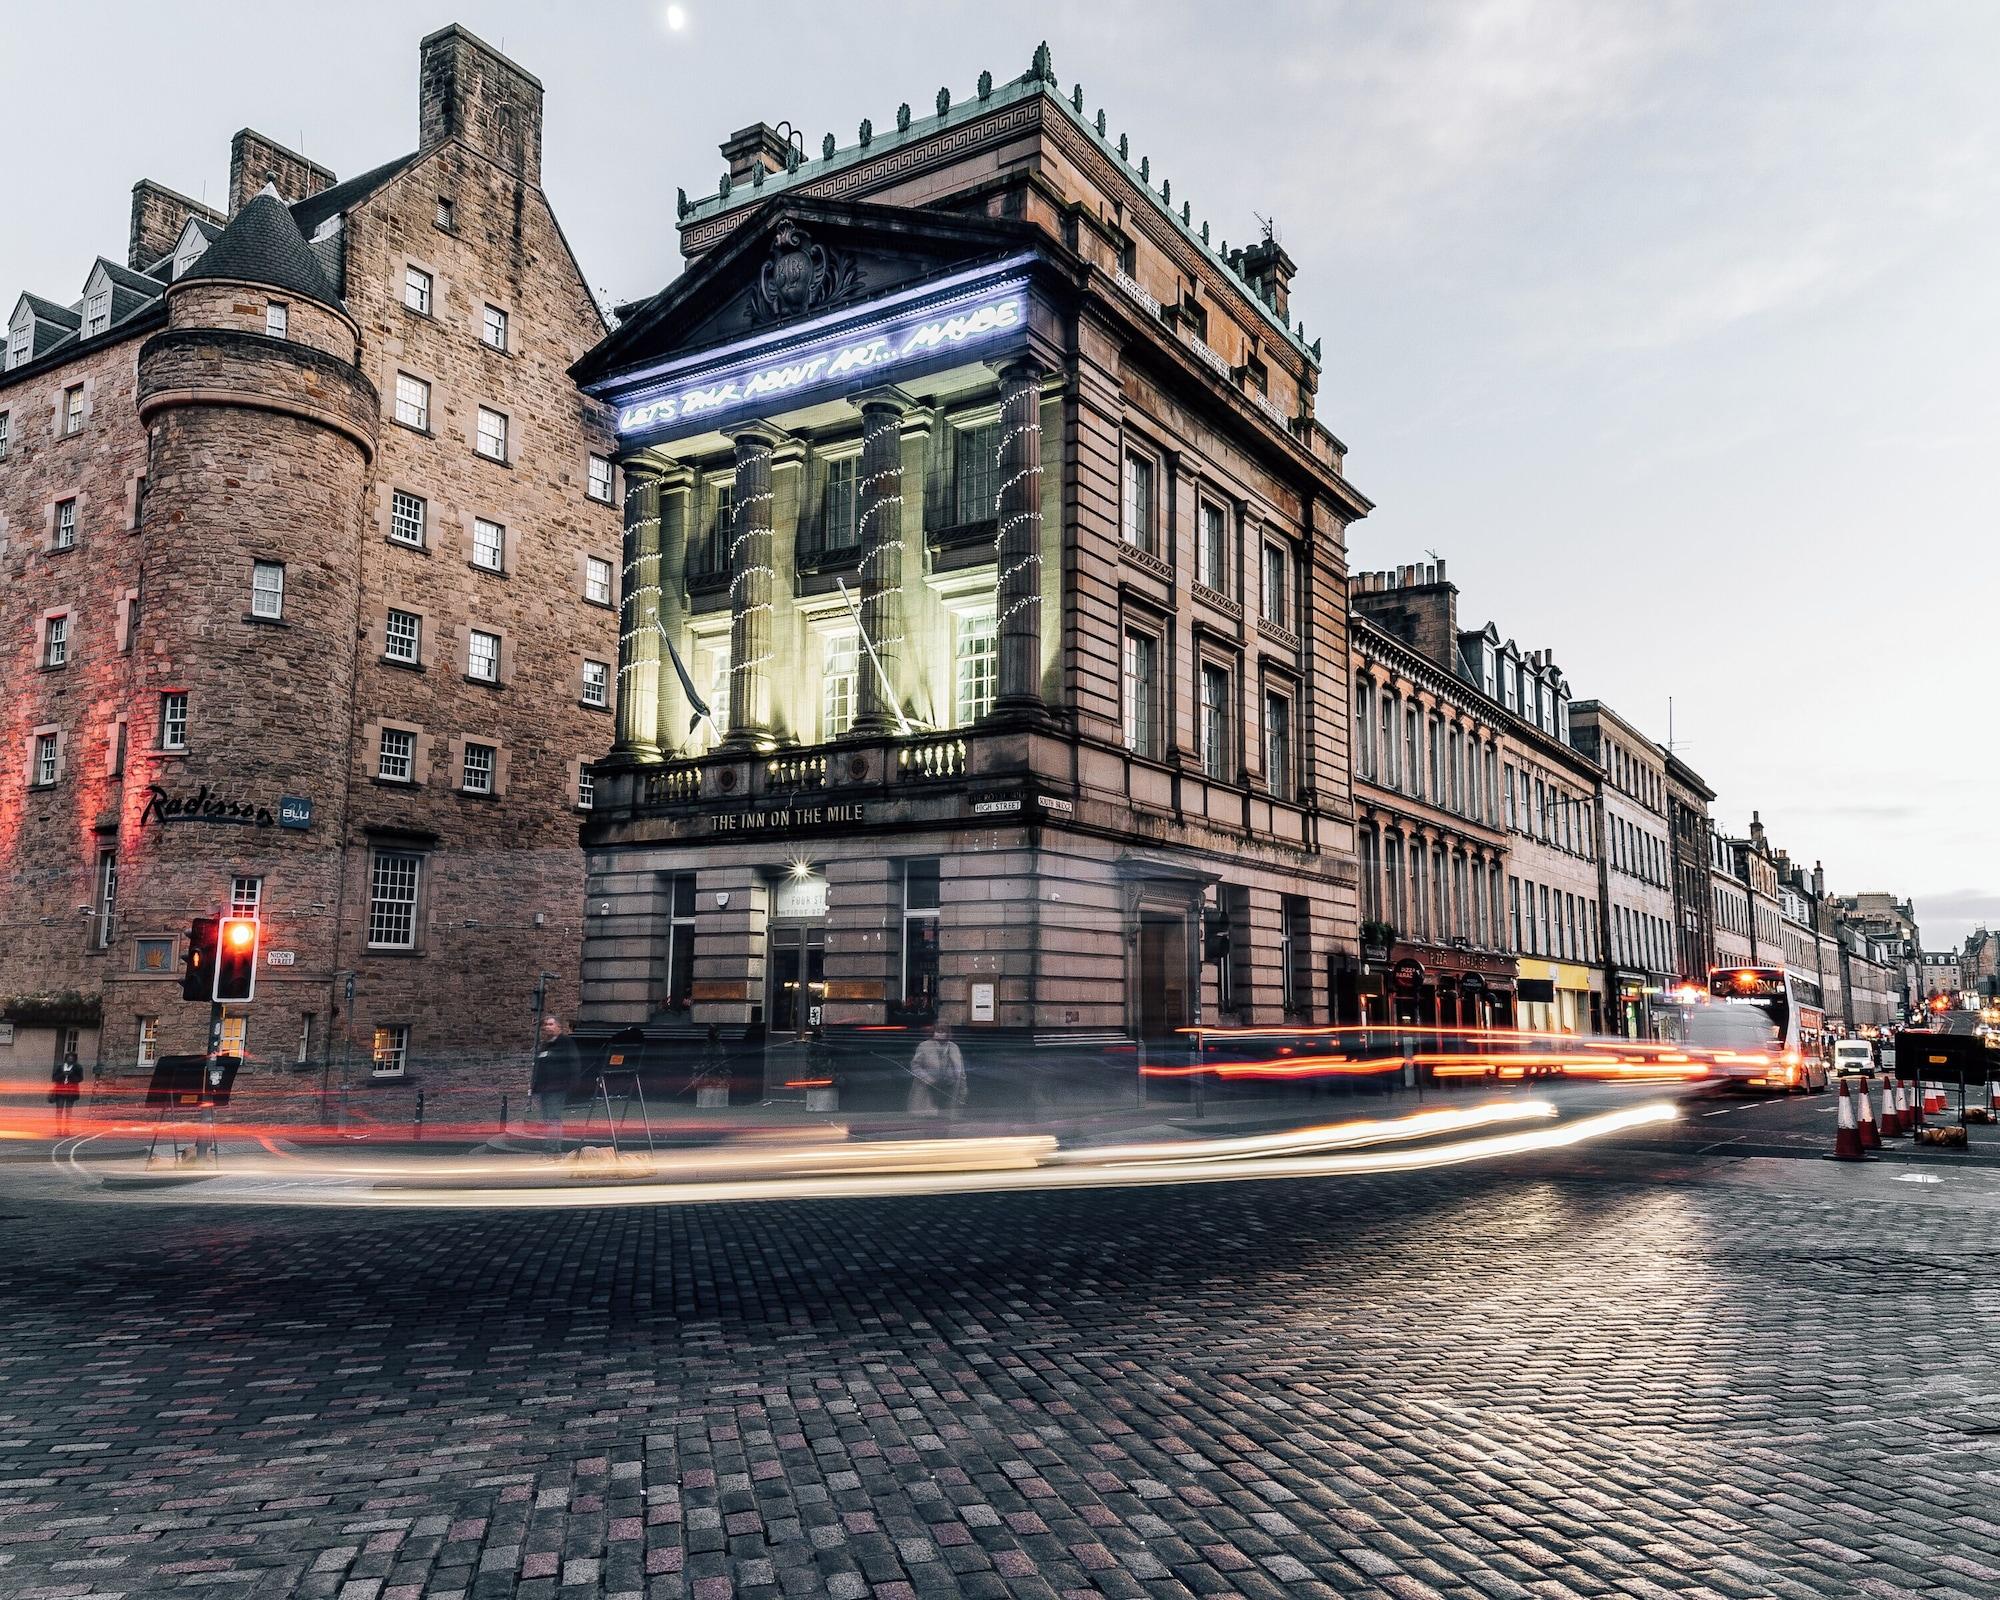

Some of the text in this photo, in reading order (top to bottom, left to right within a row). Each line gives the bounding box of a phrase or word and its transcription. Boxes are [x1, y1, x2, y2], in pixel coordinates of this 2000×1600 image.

[621, 399, 677, 429] LET'S
[682, 384, 741, 413] TALK
[744, 357, 828, 398] ABOUT
[902, 301, 1019, 354] MAYBE
[141, 785, 310, 826] Radisson BLU
[711, 804, 863, 831] THE INN ON THE MILE
[976, 801, 1020, 812] HIGH STREET
[1430, 952, 1448, 966] PZZA
